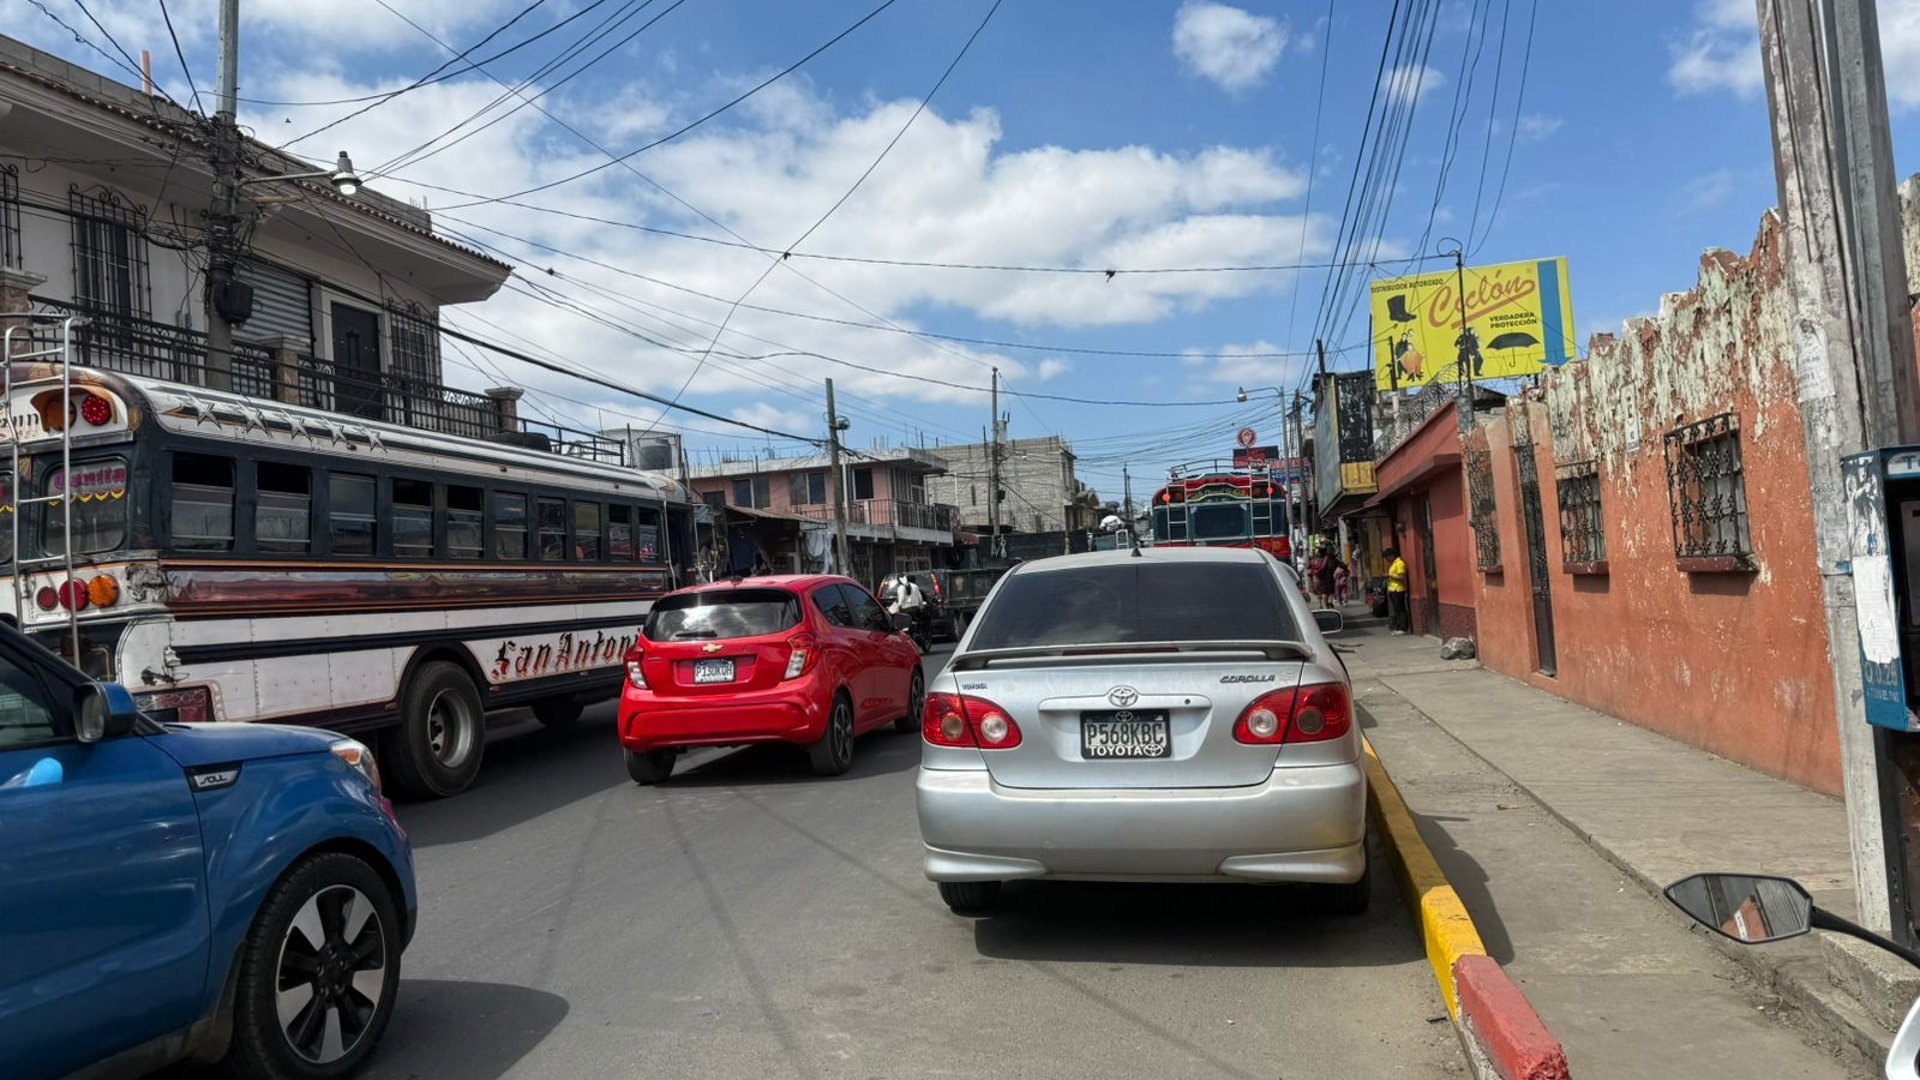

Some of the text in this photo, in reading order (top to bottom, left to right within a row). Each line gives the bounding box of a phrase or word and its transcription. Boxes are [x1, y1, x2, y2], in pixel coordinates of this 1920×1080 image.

[1371, 278, 1443, 294] DISTRIBUIDOR AUTORIZADO
[1489, 312, 1535, 322] VERDADERA
[1490, 319, 1537, 329] PROTECCIÓN
[491, 640, 552, 680] San
[1219, 674, 1275, 684] COROLLA
[1086, 722, 1164, 746] P568KBC
[1090, 745, 1144, 757] TOYOTA
[200, 774, 227, 785] SOUL
